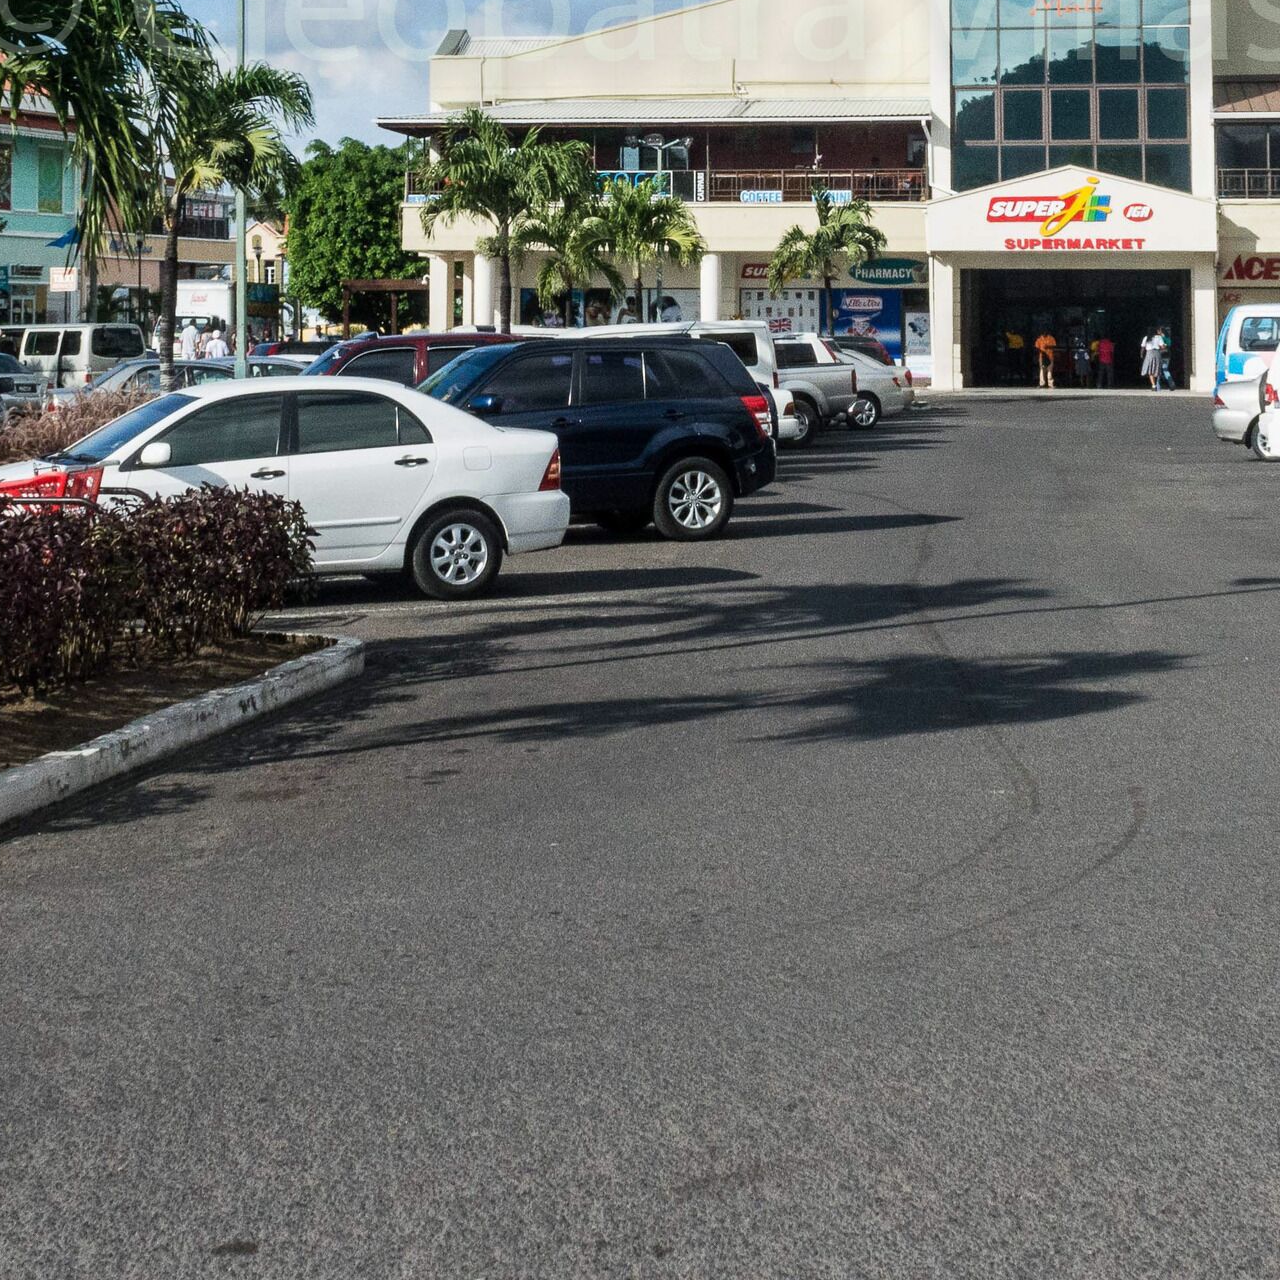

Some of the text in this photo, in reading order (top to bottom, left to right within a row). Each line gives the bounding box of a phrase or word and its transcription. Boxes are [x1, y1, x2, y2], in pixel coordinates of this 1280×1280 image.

[741, 190, 782, 203] COFFEE
[989, 200, 1066, 218] SUPER
[1126, 205, 1151, 219] IGA
[1004, 238, 1146, 250] SUPERMARKET
[855, 268, 914, 279] PHARMACY
[1221, 293, 1242, 303] ACE
